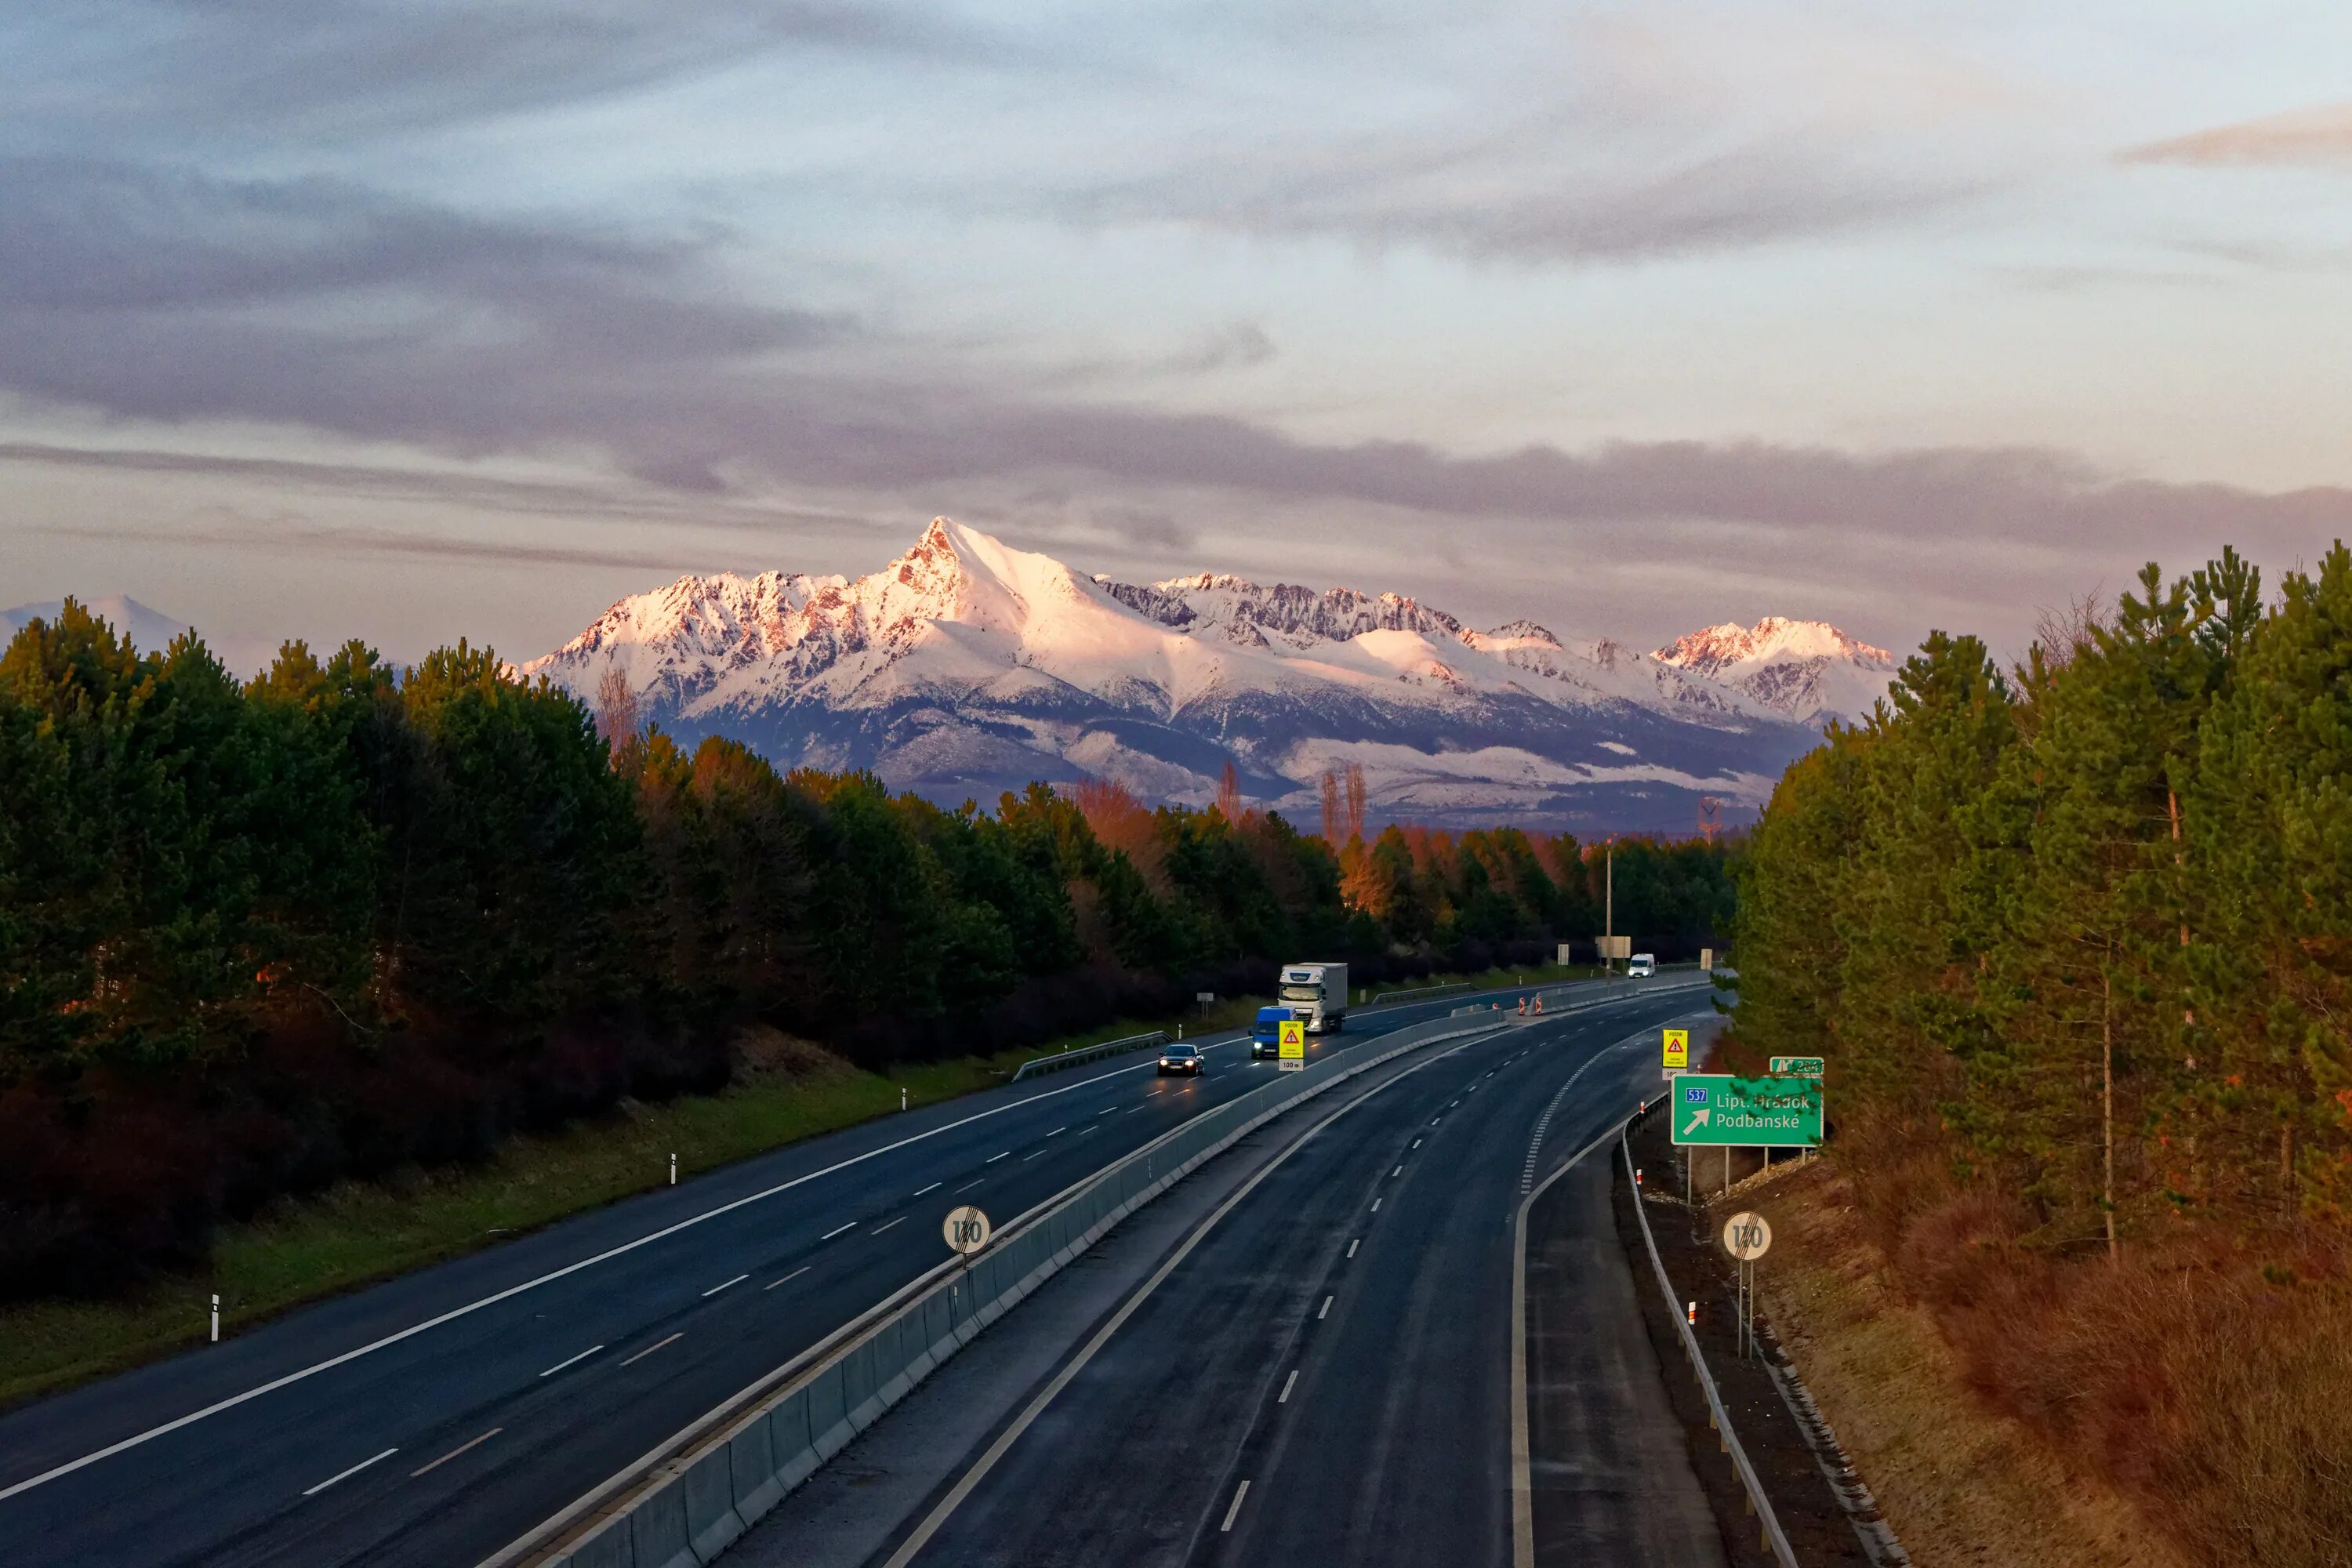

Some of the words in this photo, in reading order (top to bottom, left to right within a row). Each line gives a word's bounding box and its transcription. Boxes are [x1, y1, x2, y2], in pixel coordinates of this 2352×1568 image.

[1688, 1090, 1706, 1101] 537
[1717, 1093, 1750, 1111] Lipt.
[1716, 1113, 1799, 1128] Podbanské
[953, 1221, 982, 1243] 110
[1733, 1225, 1763, 1248] 110
